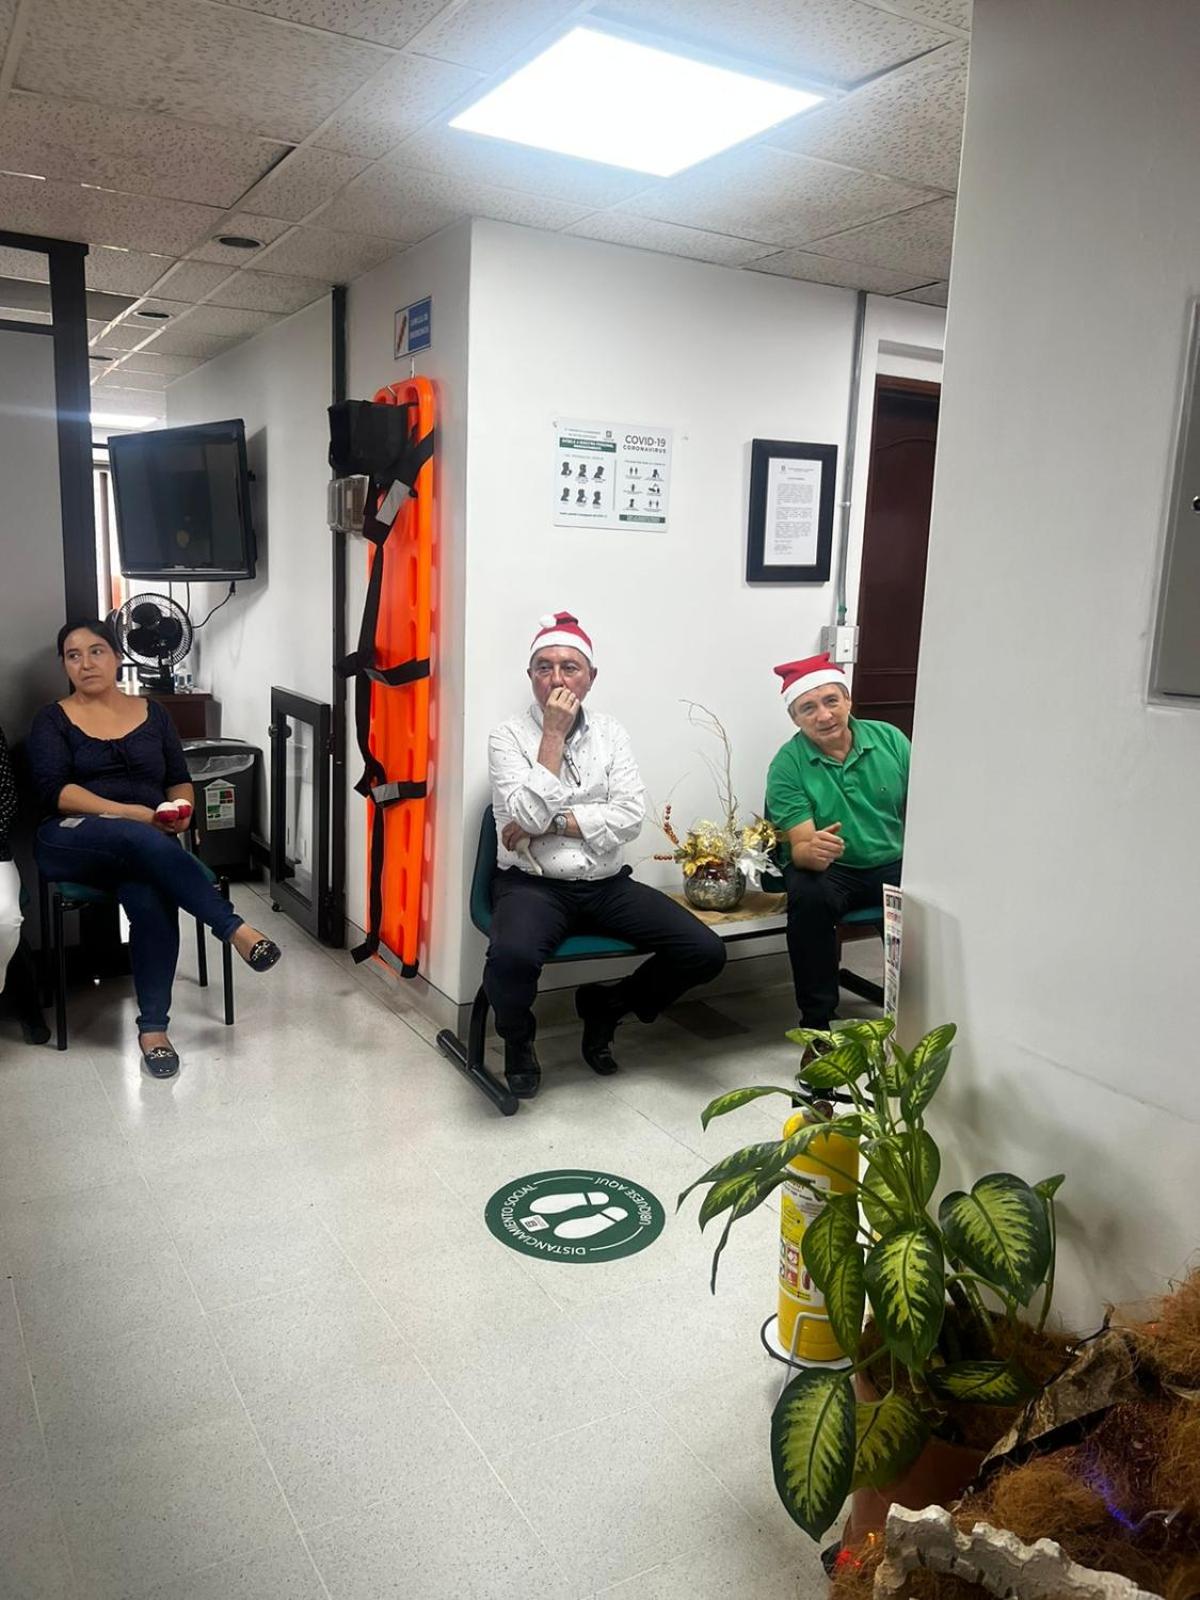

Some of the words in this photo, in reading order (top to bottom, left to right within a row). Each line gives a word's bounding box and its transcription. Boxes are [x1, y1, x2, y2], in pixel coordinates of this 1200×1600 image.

[622, 444, 666, 453] CORONAVIRUS
[625, 434, 666, 447] COVID-19
[504, 1184, 538, 1207] SOCIAL
[501, 1206, 586, 1255] DISTANCIAMIENTO
